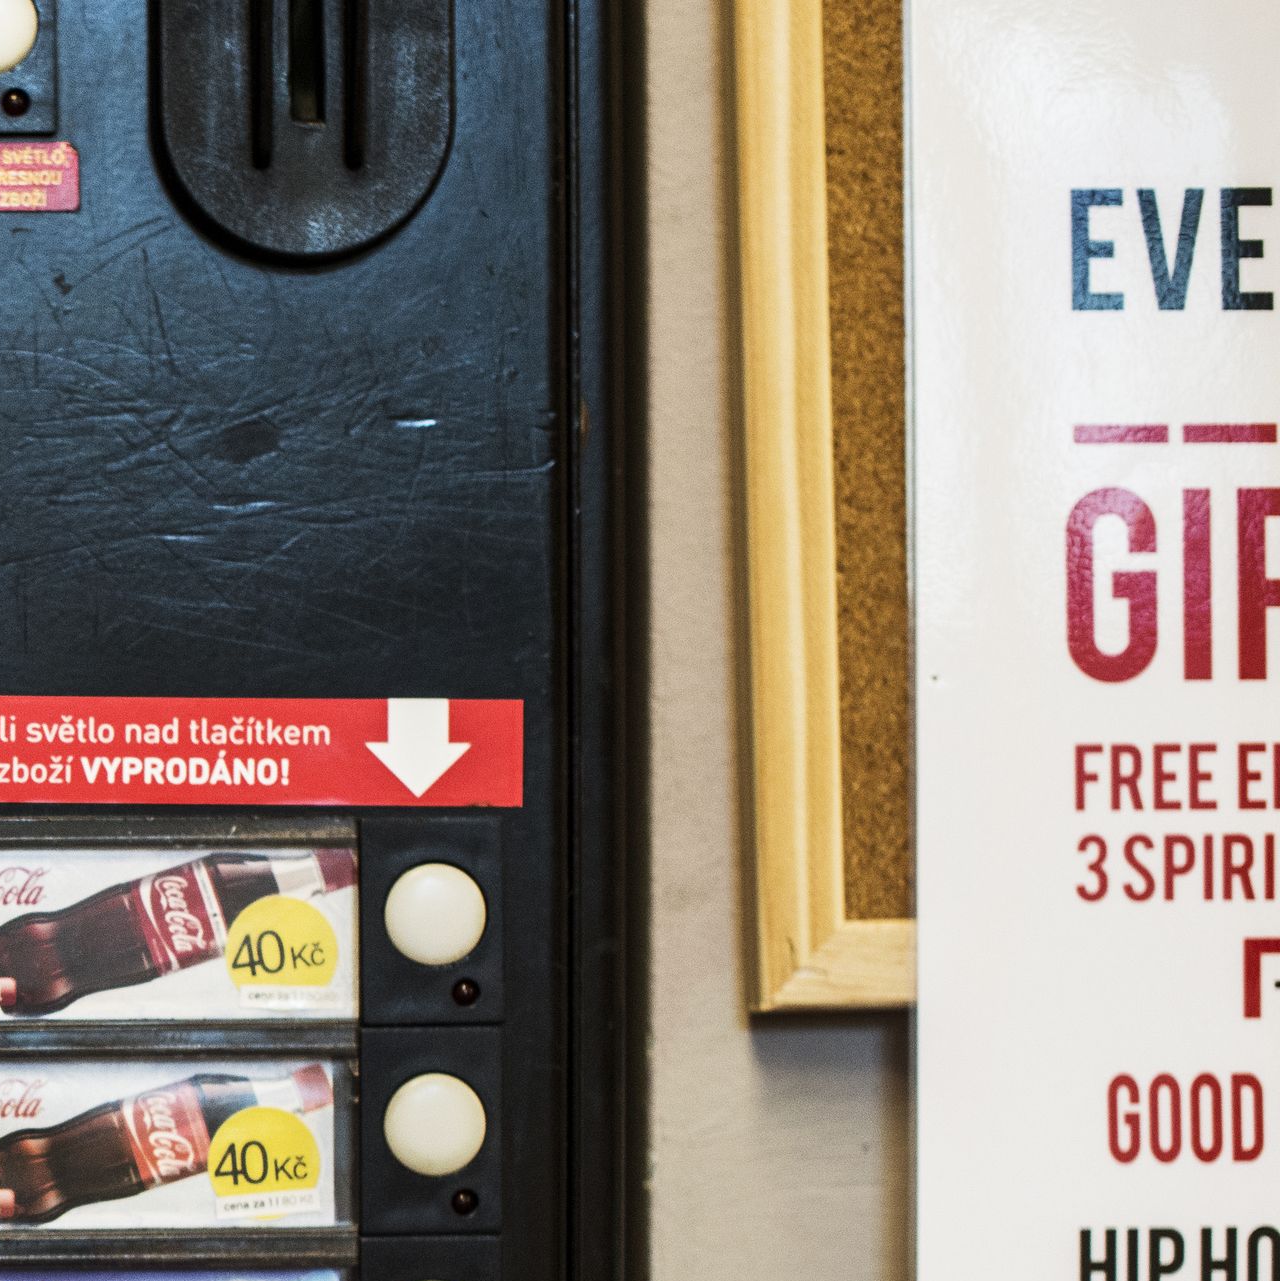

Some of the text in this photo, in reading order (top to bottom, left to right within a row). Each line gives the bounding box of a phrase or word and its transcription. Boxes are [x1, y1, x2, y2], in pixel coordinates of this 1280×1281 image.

[26, 715, 115, 744] světlo
[125, 716, 180, 745] nad
[188, 717, 331, 747] tlačítkem
[81, 756, 290, 787] VYPRODÁNO!
[1074, 742, 1280, 811] FREE E
[1076, 833, 1276, 902] 3 SPIRI
[1107, 1071, 1265, 1164] GOOD
